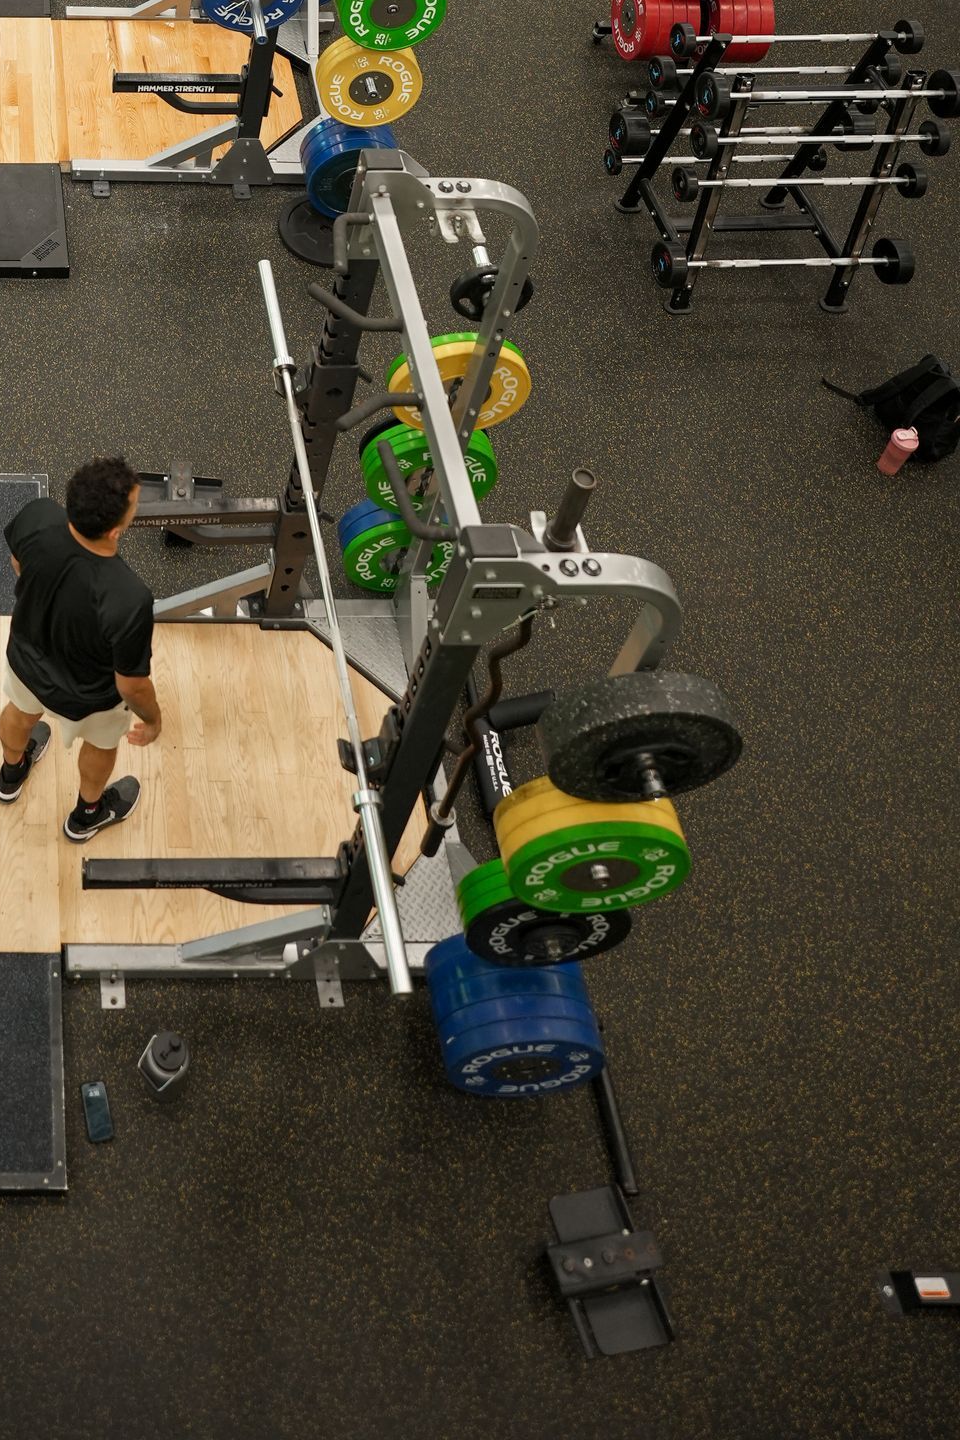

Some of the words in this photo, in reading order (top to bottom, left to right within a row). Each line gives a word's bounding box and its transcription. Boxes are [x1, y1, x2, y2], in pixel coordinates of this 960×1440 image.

[374, 33, 386, 46] 25
[357, 55, 370, 68] 35
[174, 85, 215, 93] STRENGTH
[378, 55, 413, 104] ROGUE
[329, 73, 365, 121] ROGUE
[373, 108, 386, 120] 35
[479, 366, 518, 422] ROGUE
[169, 517, 221, 525] STRENGTH
[355, 536, 396, 581] ROGUE
[381, 578, 393, 589] 25
[489, 730, 513, 797] ROGUE
[525, 841, 621, 886] ROGUE
[533, 888, 557, 901] 25
[581, 864, 675, 908] ROGUE
[489, 911, 538, 956] ROGUE
[461, 1044, 556, 1073] ROGUE
[498, 1064, 592, 1093] ROGUE
